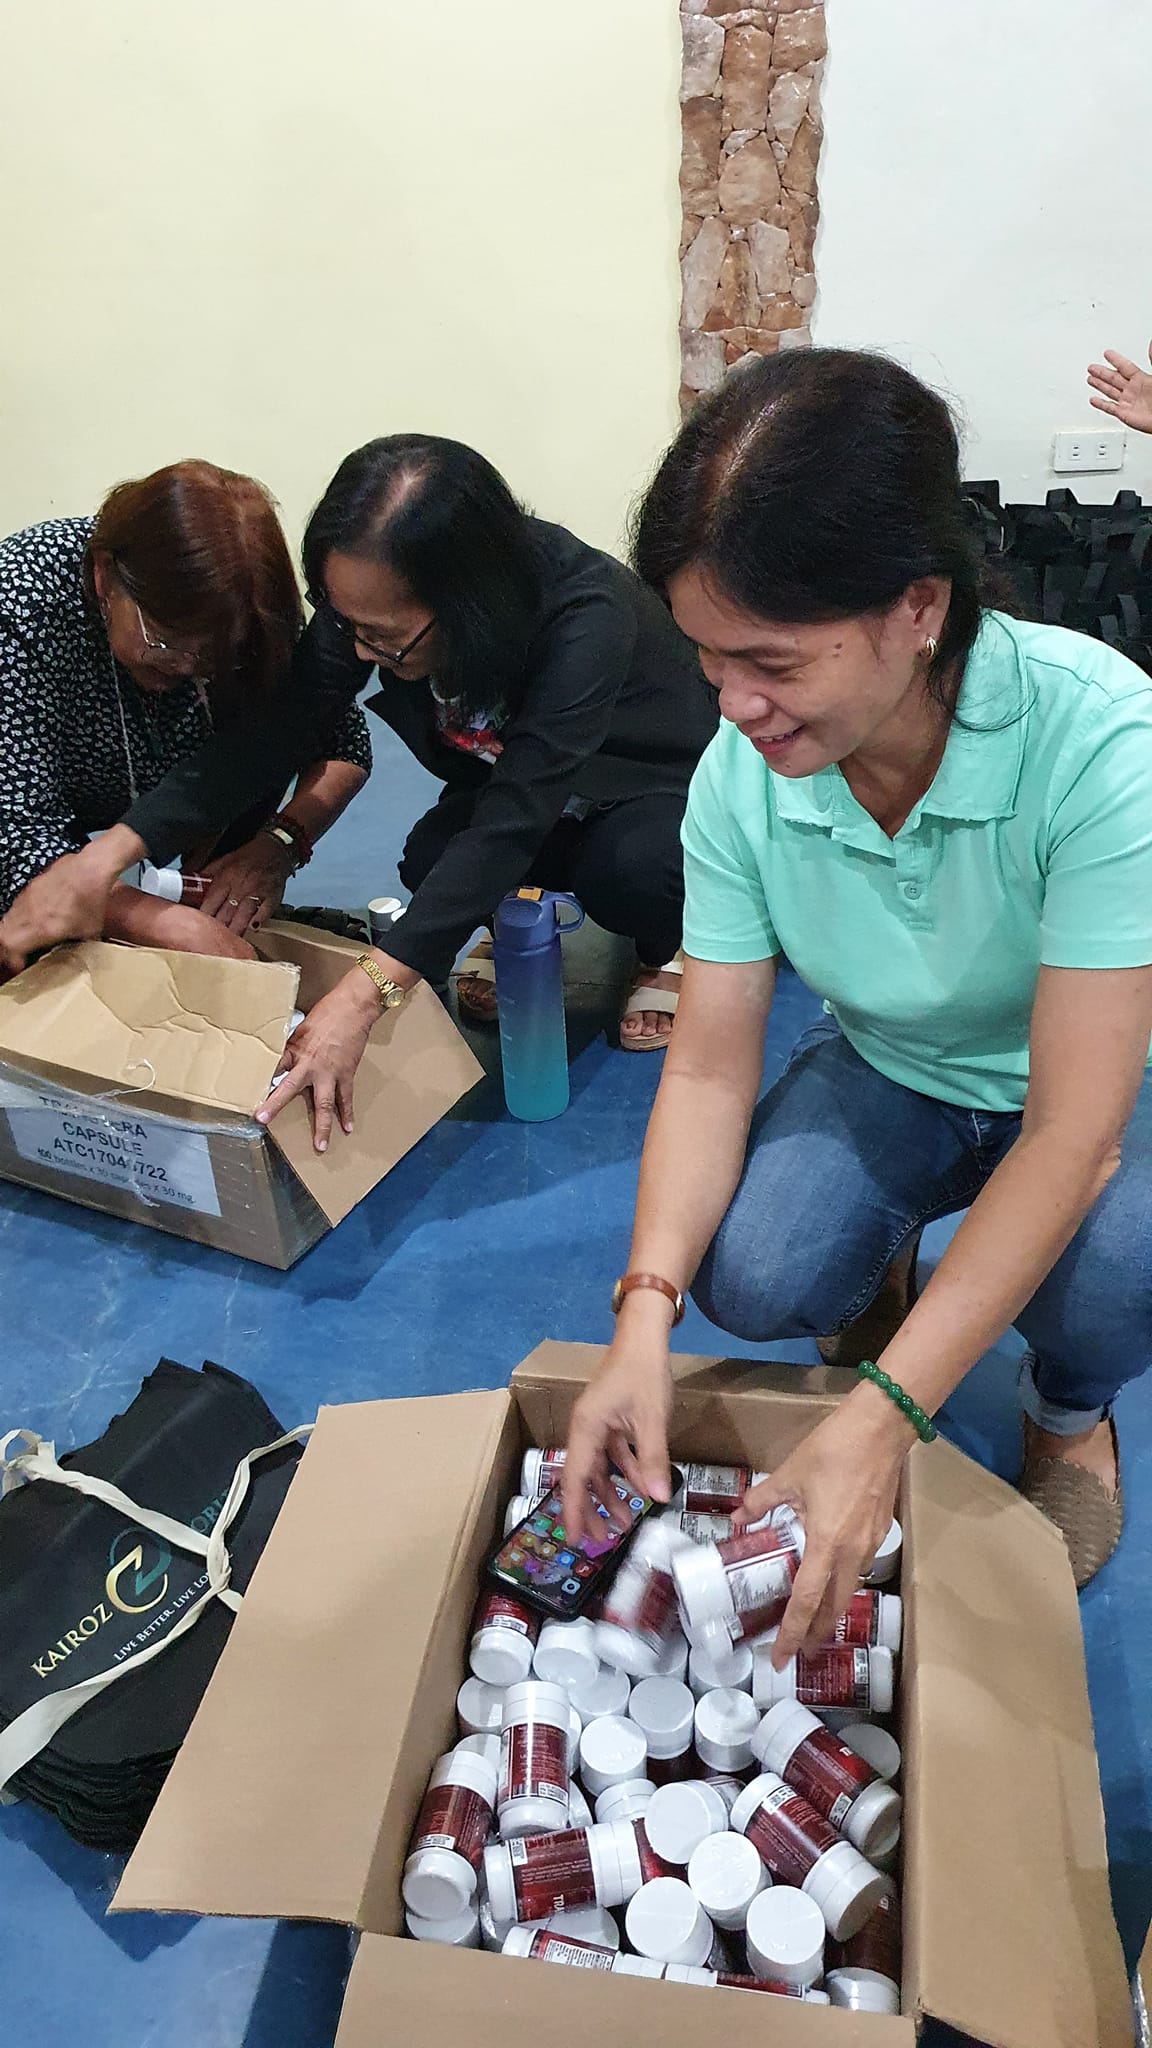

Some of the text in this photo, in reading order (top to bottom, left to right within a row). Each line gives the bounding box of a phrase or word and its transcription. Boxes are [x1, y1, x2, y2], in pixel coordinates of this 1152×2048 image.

[63, 1122, 143, 1156] CAPSULE
[31, 1603, 113, 1678] KAIROZ
[114, 1571, 209, 1661] LIVE BETTER. LIVE LO
